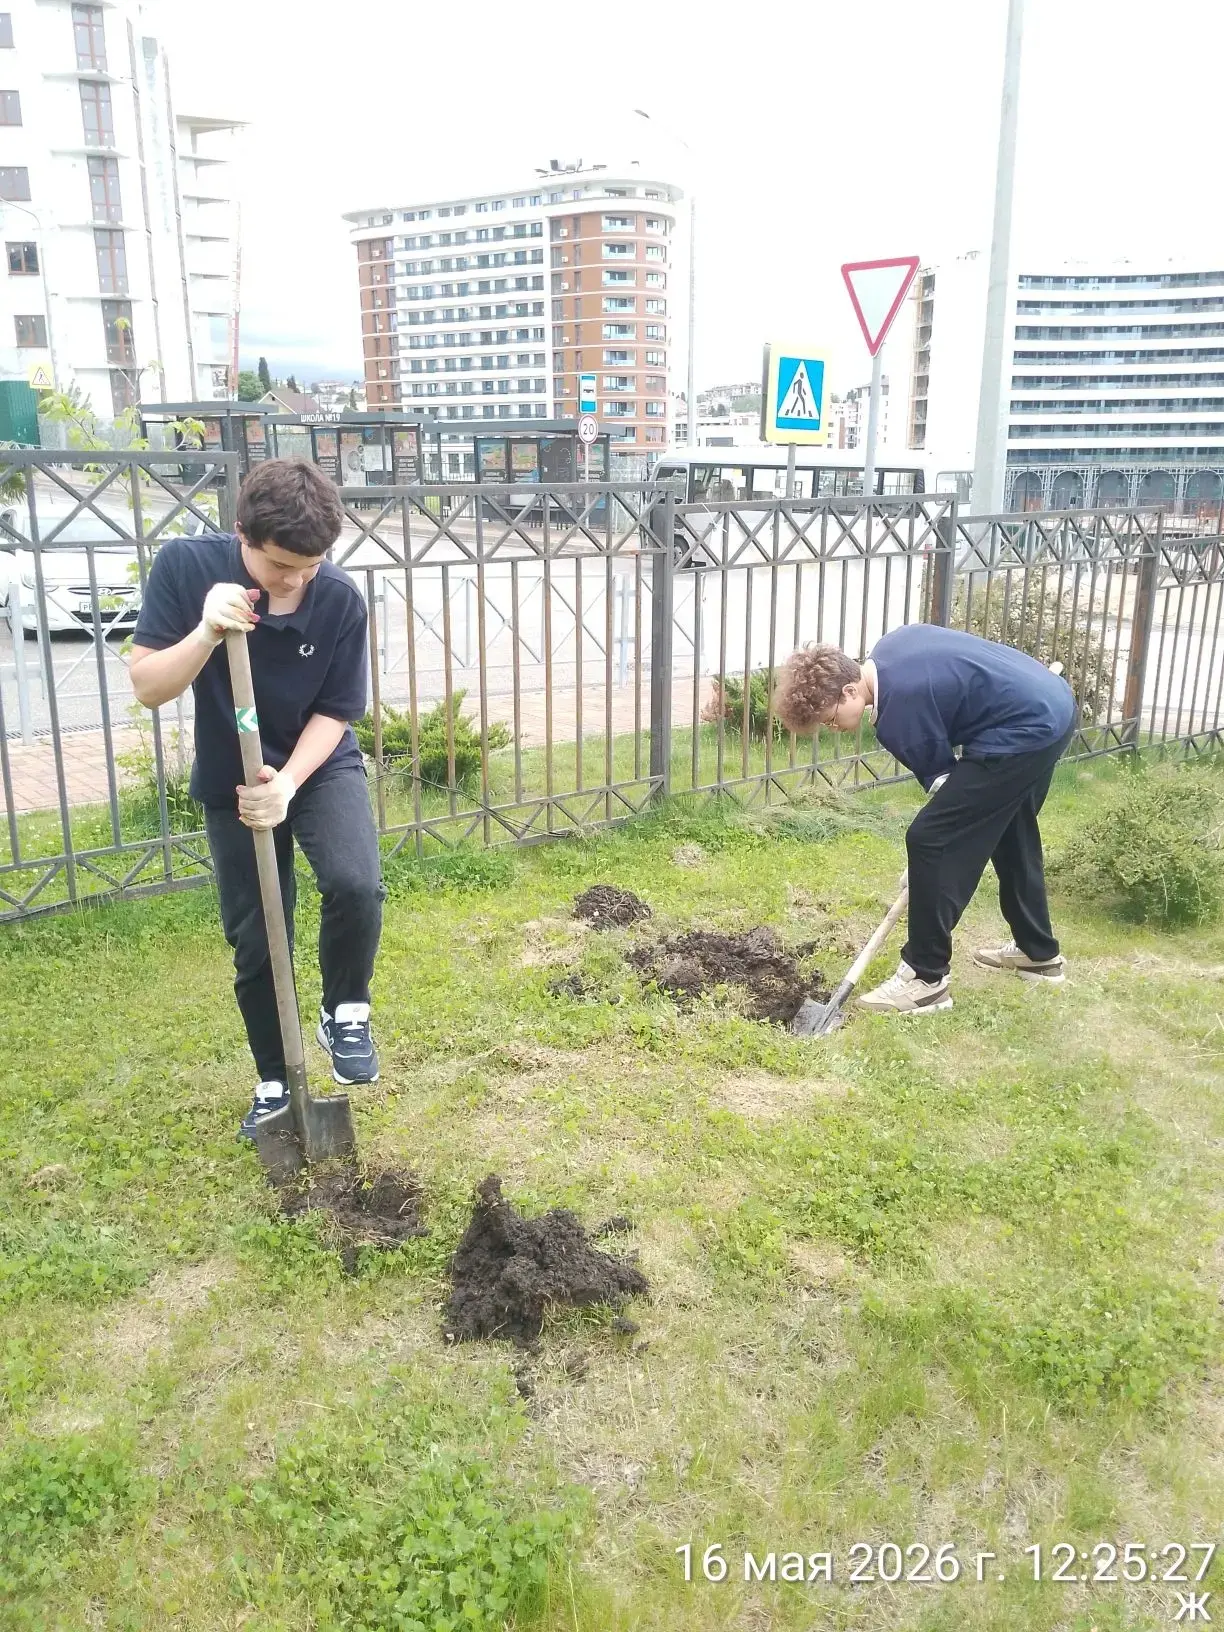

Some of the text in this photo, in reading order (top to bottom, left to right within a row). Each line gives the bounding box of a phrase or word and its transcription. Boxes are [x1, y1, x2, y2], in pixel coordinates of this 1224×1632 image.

[300, 413, 341, 422] ШКОЛА №19
[583, 424, 594, 435] 20
